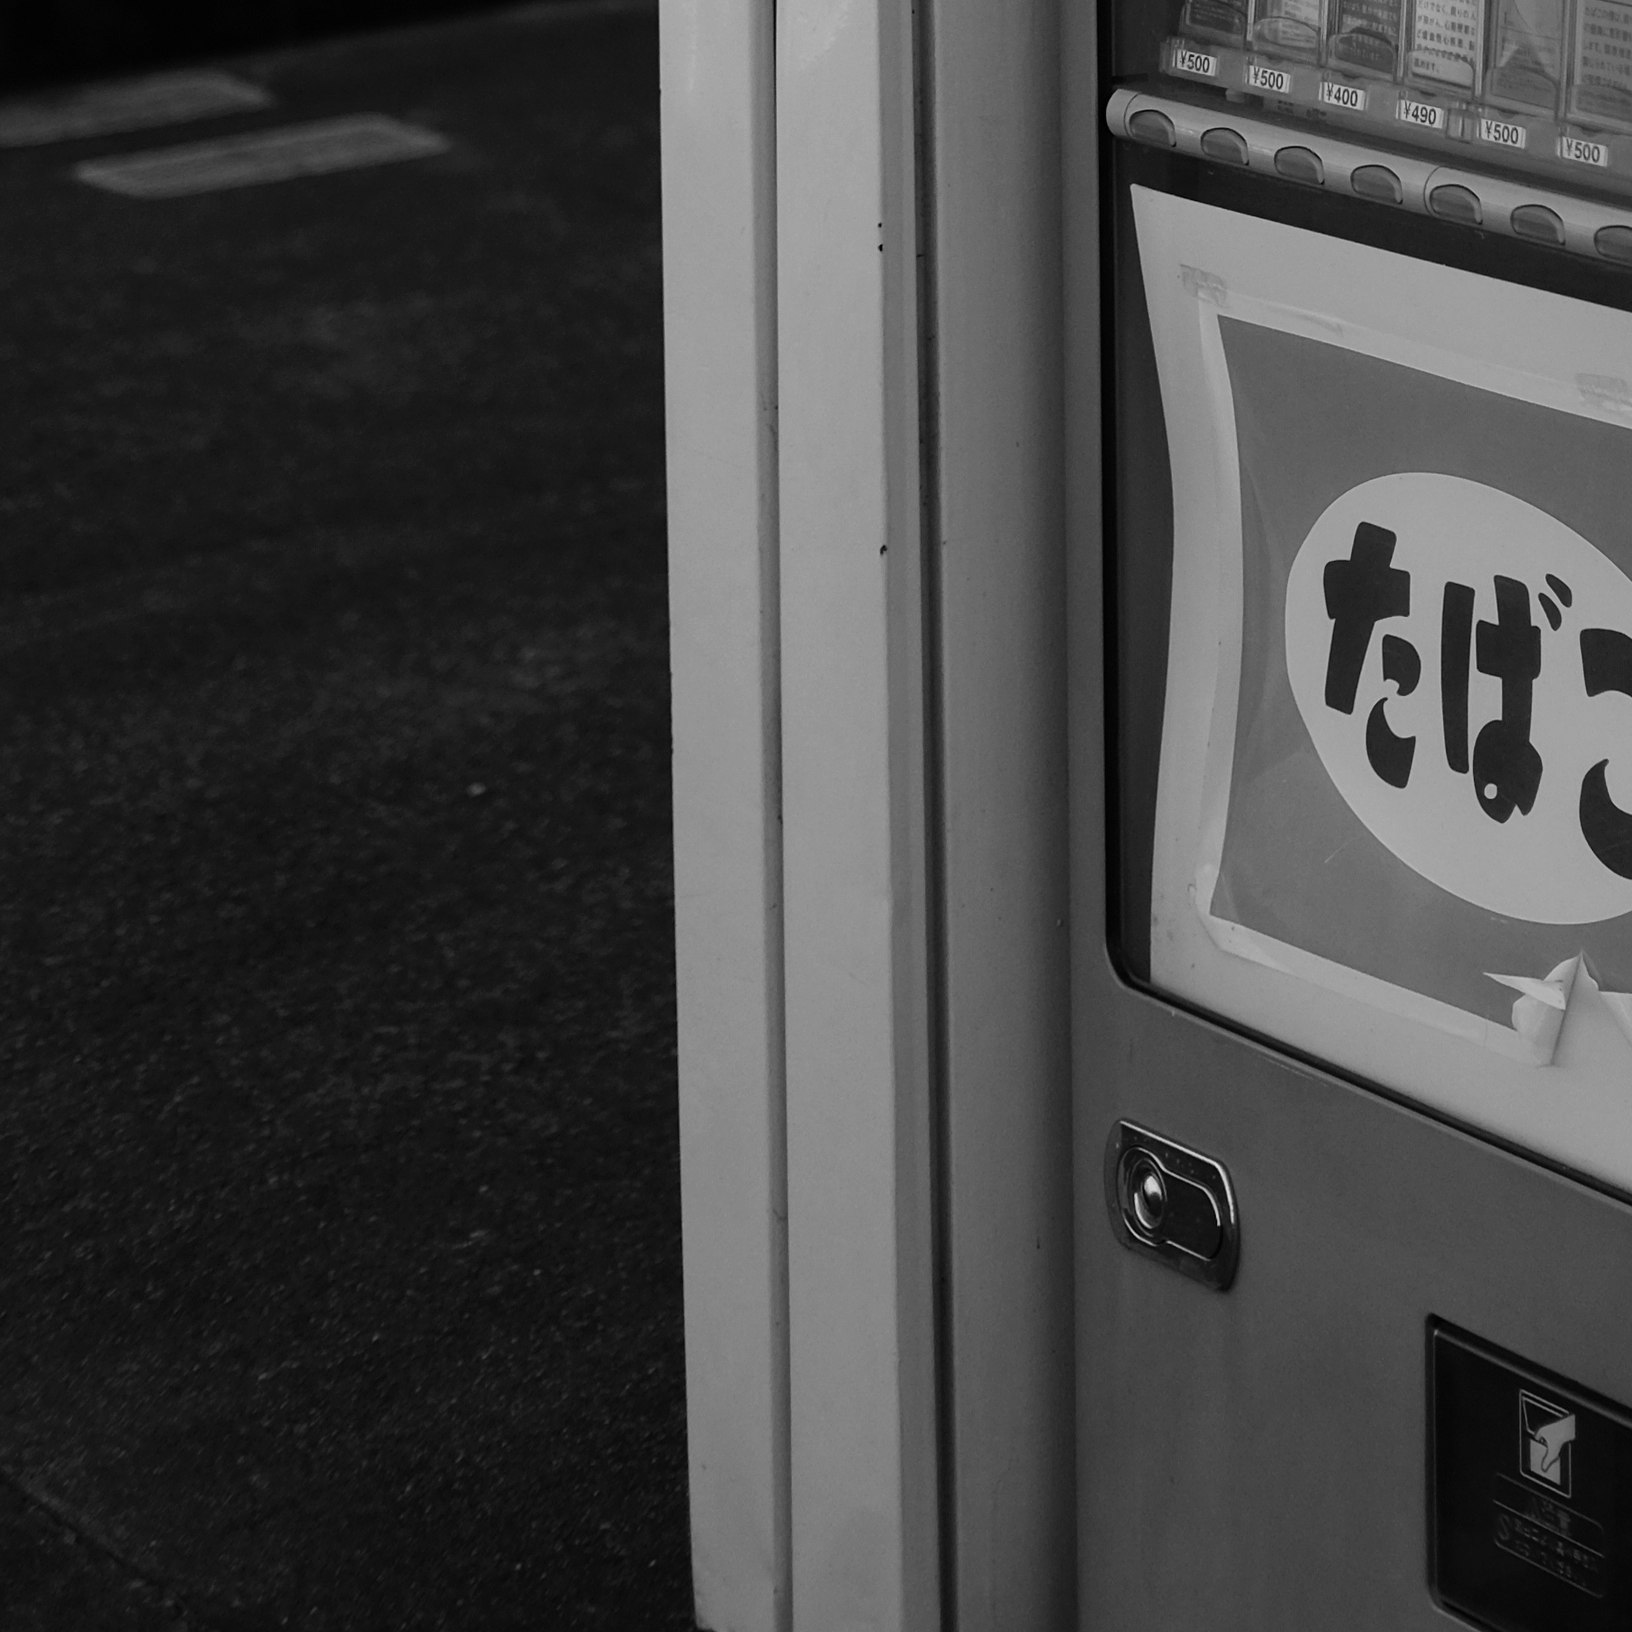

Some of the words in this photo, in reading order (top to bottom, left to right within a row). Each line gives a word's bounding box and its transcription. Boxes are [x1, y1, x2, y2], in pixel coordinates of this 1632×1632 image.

[1180, 52, 1210, 74] ¥500
[1253, 67, 1284, 90] ¥500
[1327, 83, 1359, 107] ¥400
[1401, 100, 1437, 125] ¥490
[1484, 120, 1519, 144] ¥500
[1566, 138, 1601, 162] ¥500
